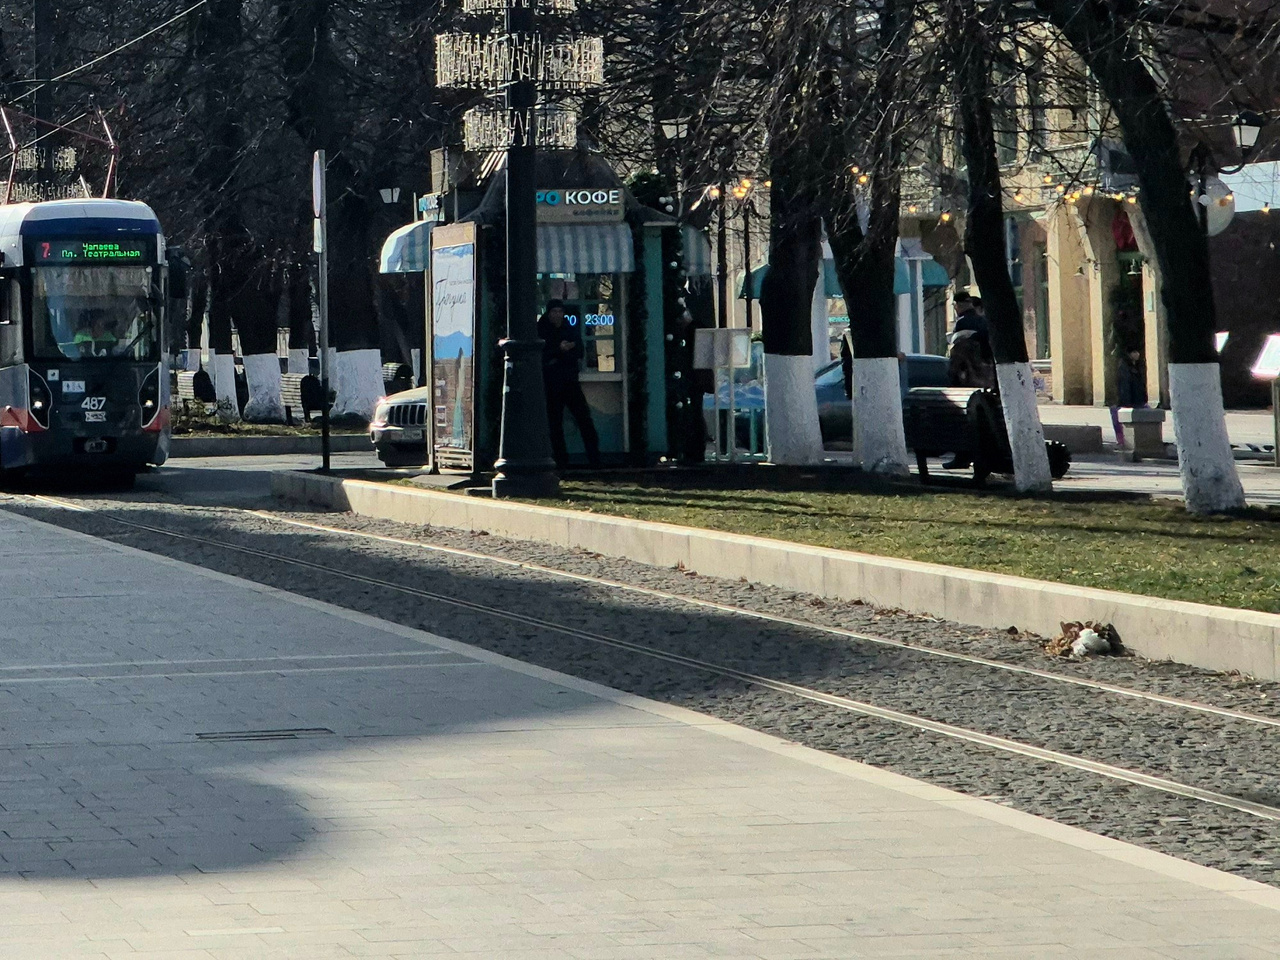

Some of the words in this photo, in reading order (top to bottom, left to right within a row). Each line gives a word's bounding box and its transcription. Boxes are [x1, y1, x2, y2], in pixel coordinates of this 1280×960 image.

[537, 191, 561, 206] РО
[565, 190, 620, 205] КОФЕ
[41, 242, 51, 258] 7
[82, 243, 120, 251] Чапаева
[83, 249, 141, 258] Театральная
[584, 313, 615, 326] 23:00
[81, 396, 106, 410] 487
